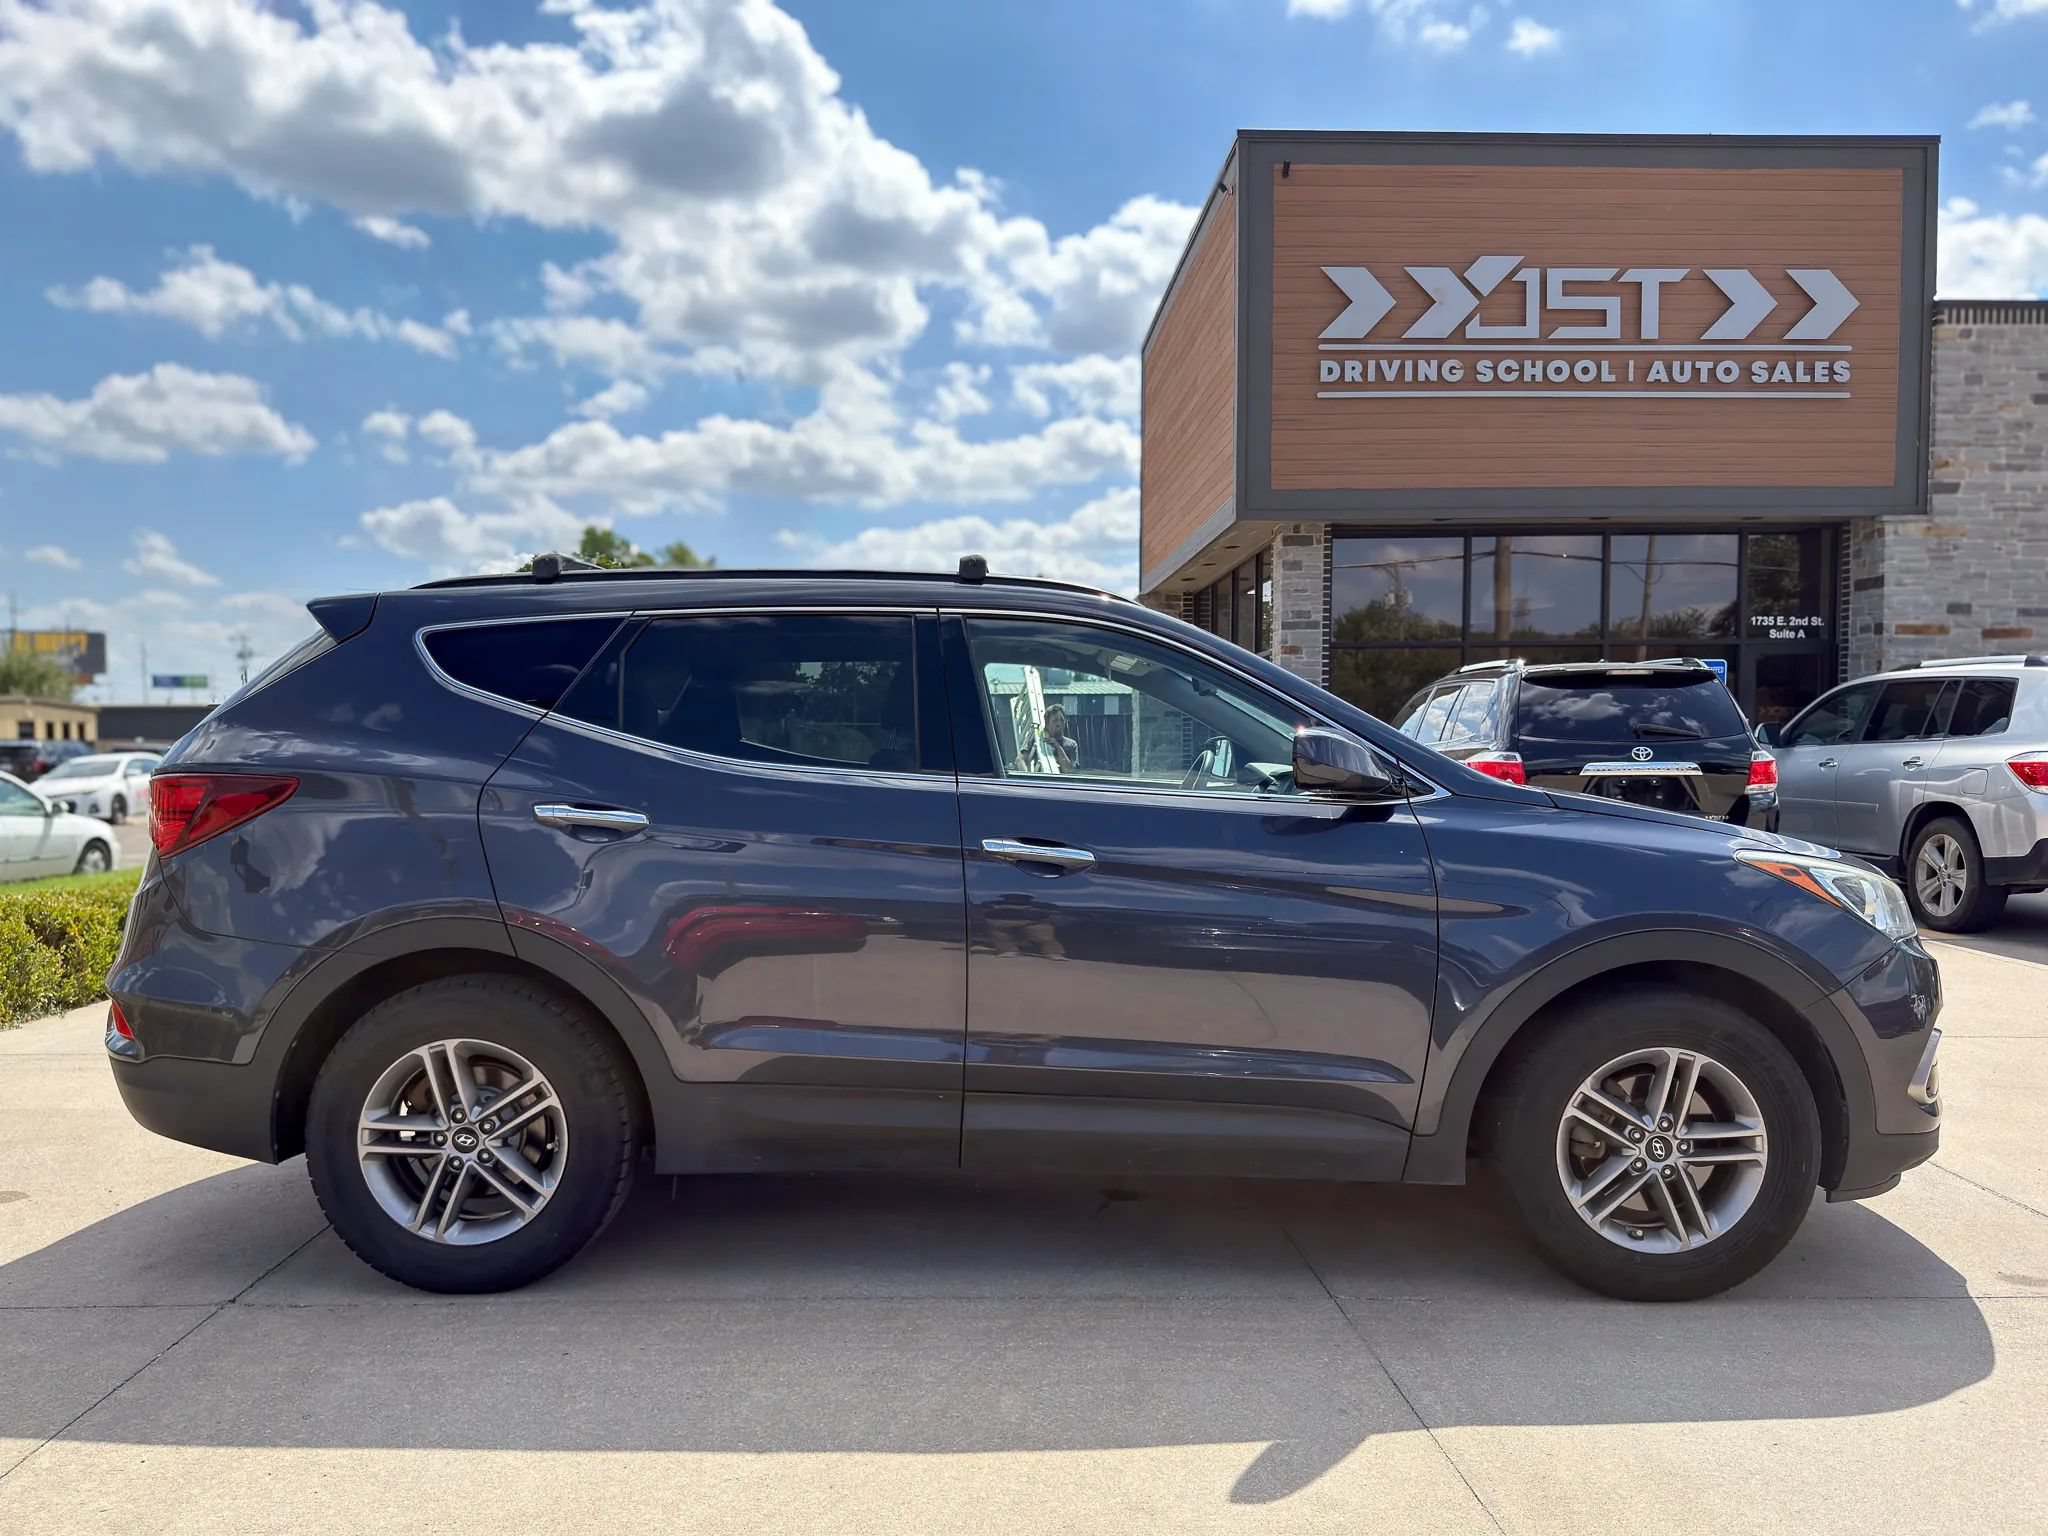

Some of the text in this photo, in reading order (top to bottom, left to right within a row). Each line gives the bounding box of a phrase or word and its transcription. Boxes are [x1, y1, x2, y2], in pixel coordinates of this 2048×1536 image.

[1319, 358, 1850, 384] DRIVING SCHOOL AUTO SALES
[1750, 616, 1825, 626] 1735 E. 2nd St.
[1768, 628, 1806, 639] Suite A
